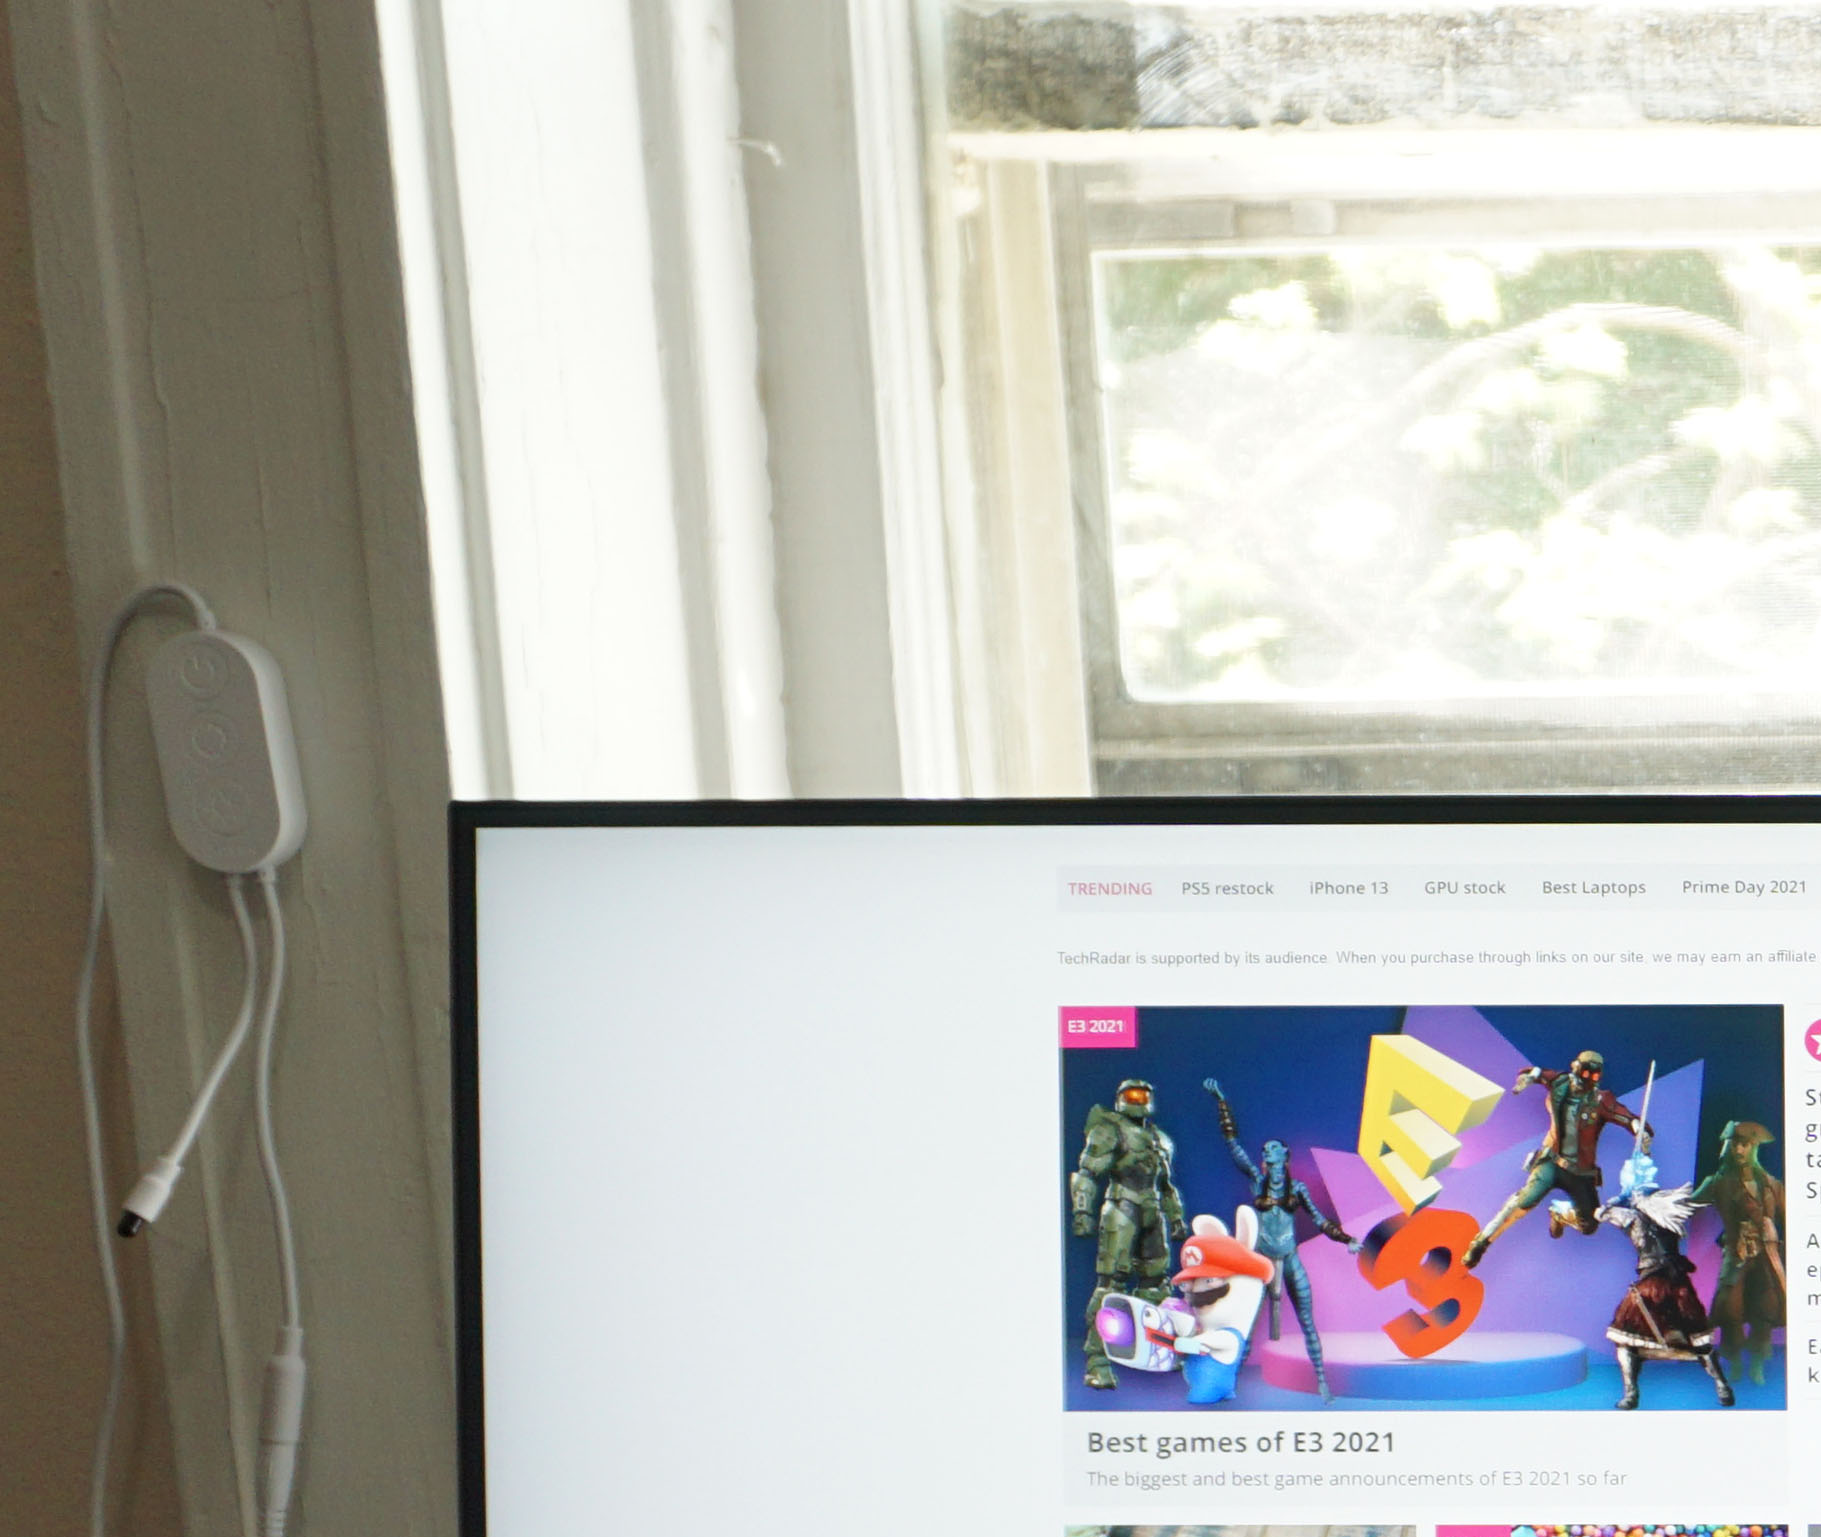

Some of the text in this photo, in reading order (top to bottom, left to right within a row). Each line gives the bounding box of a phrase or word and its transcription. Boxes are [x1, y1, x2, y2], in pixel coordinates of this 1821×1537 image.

[1068, 881, 1153, 896] TRENDING
[1181, 880, 1274, 895] PS5 restock
[1309, 880, 1389, 895] iPhone 13
[1424, 880, 1507, 895] GPU stock
[1542, 880, 1647, 898] Best Laptops
[1682, 880, 1807, 898] Prime Day 2021
[1057, 951, 1131, 965] TechRadar
[1135, 951, 1146, 965] is
[1150, 951, 1220, 968] supported
[1224, 951, 1240, 968] by
[1244, 951, 1260, 965] its
[1336, 951, 1376, 965] When
[1380, 955, 1406, 968] you
[1410, 951, 1475, 968] purchase
[1478, 951, 1532, 967] through
[1535, 949, 1567, 964] links
[1571, 953, 1588, 964] on
[1592, 953, 1616, 964] our
[1652, 953, 1673, 964] we
[1676, 953, 1706, 967] may
[1710, 953, 1742, 964] earn
[1746, 953, 1764, 964] an
[1767, 949, 1817, 964] affiliate
[1068, 1019, 1124, 1033] E3 2021
[1088, 1430, 1396, 1460] Best games of E3 2021
[1087, 1468, 1628, 1492] The biggest and best game announcements of E3 2021 so far
